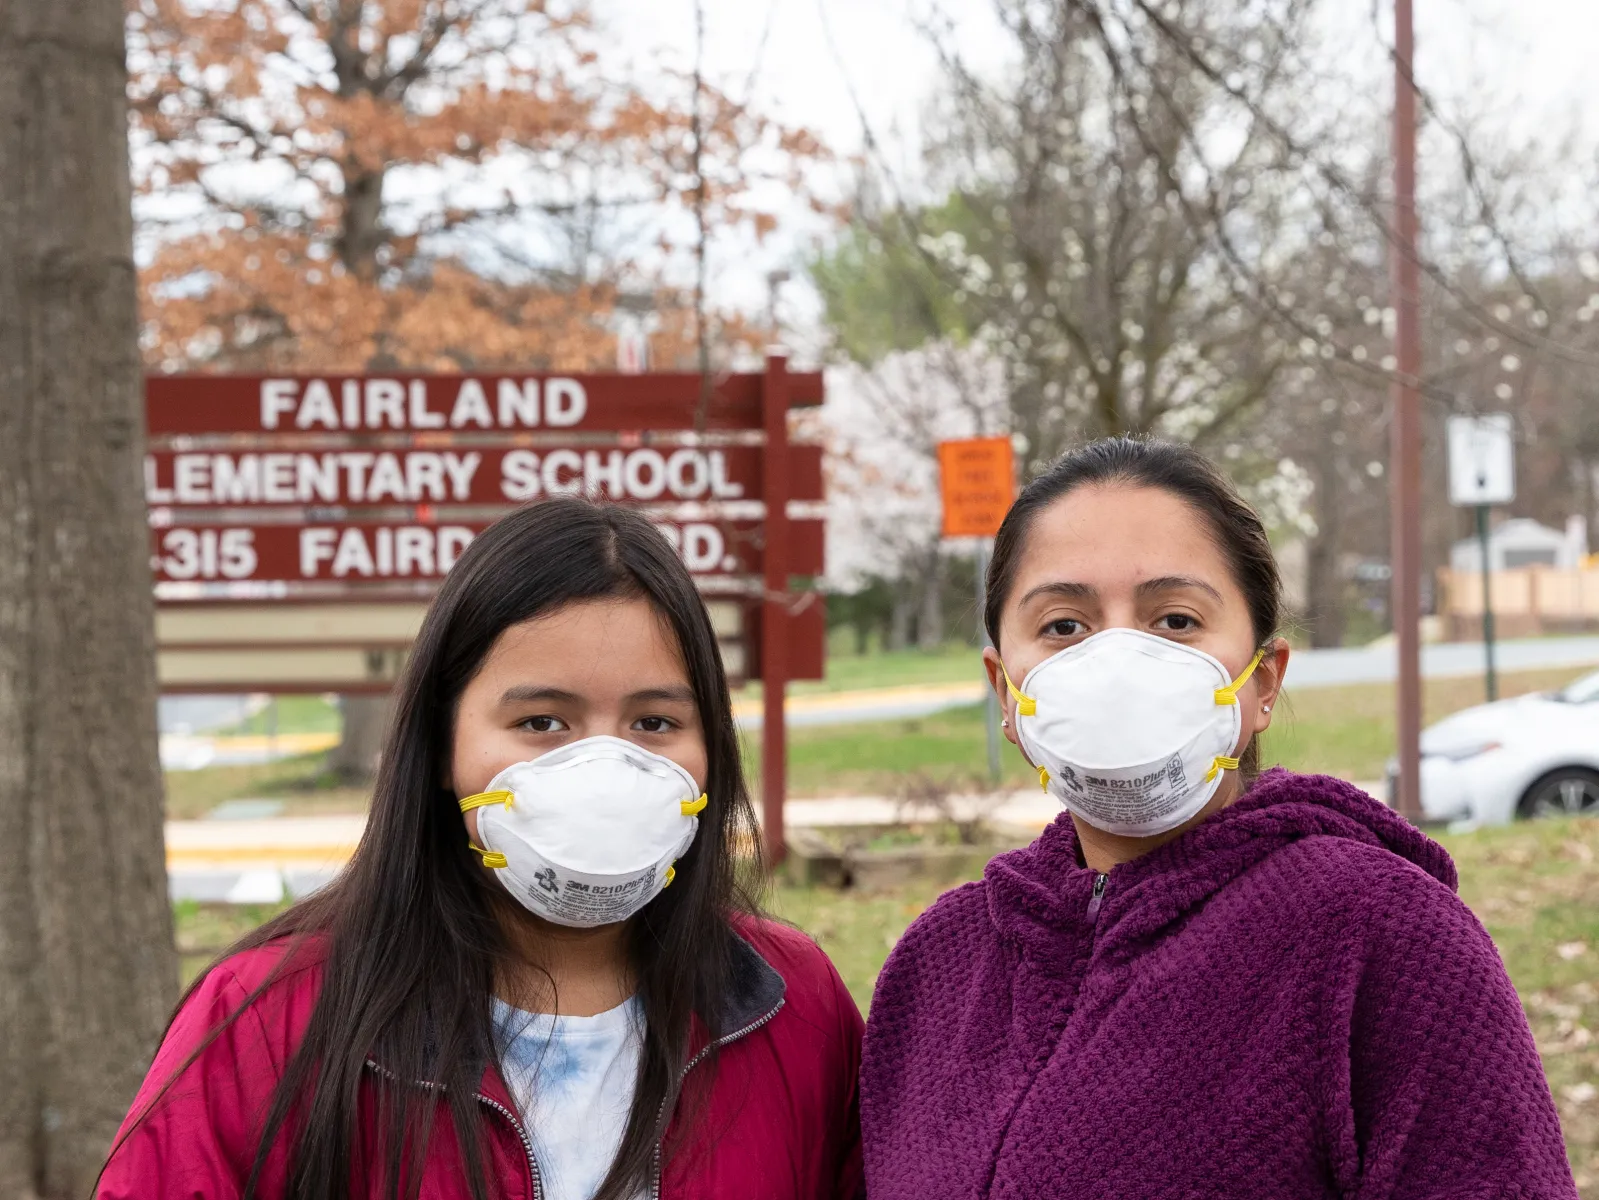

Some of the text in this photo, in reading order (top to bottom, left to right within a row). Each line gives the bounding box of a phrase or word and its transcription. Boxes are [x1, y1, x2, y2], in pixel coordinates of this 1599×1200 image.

[260, 377, 588, 428] FAIRLAND
[144, 448, 744, 503] LEMENTARY SCHOOL
[150, 527, 258, 580] 315
[300, 526, 475, 577] FAIRD
[1085, 775, 1108, 787] 3M
[567, 880, 589, 892] 3M
